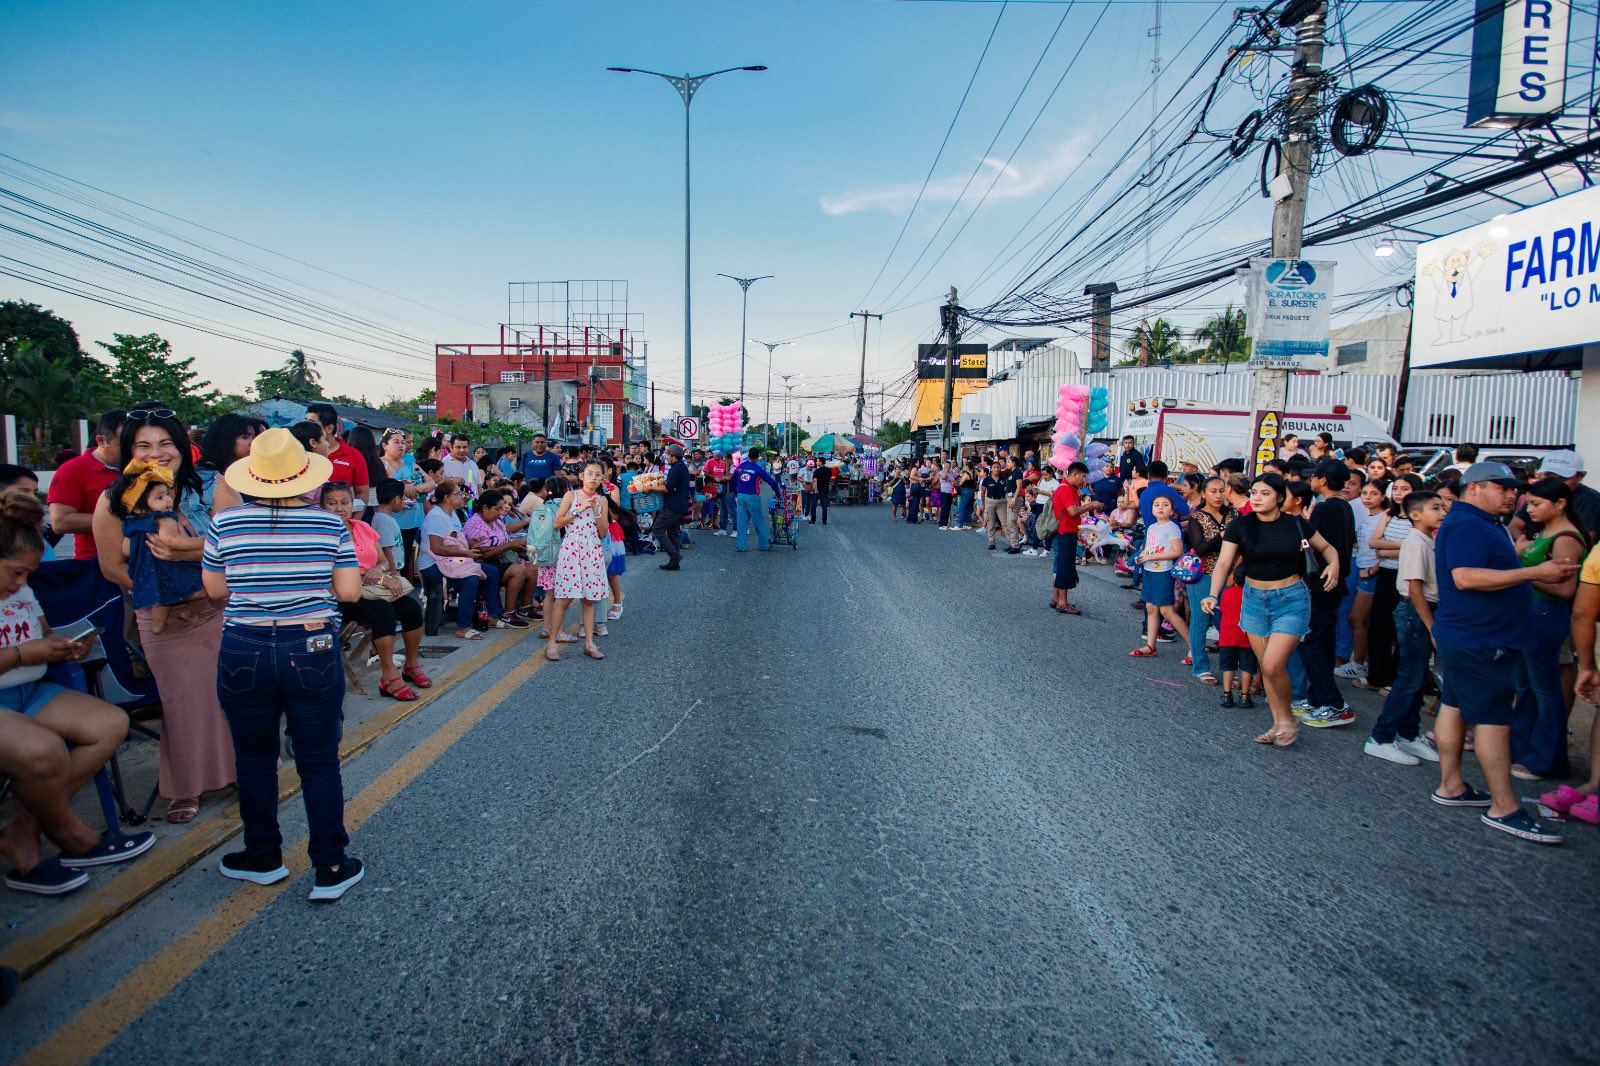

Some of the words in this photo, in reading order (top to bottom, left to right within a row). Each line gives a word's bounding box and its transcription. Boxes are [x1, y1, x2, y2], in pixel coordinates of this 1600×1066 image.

[1505, 221, 1600, 292] FARM
[1281, 300, 1318, 308] SURESTE
[1541, 287, 1581, 310] "LO
[962, 357, 985, 366] Store
